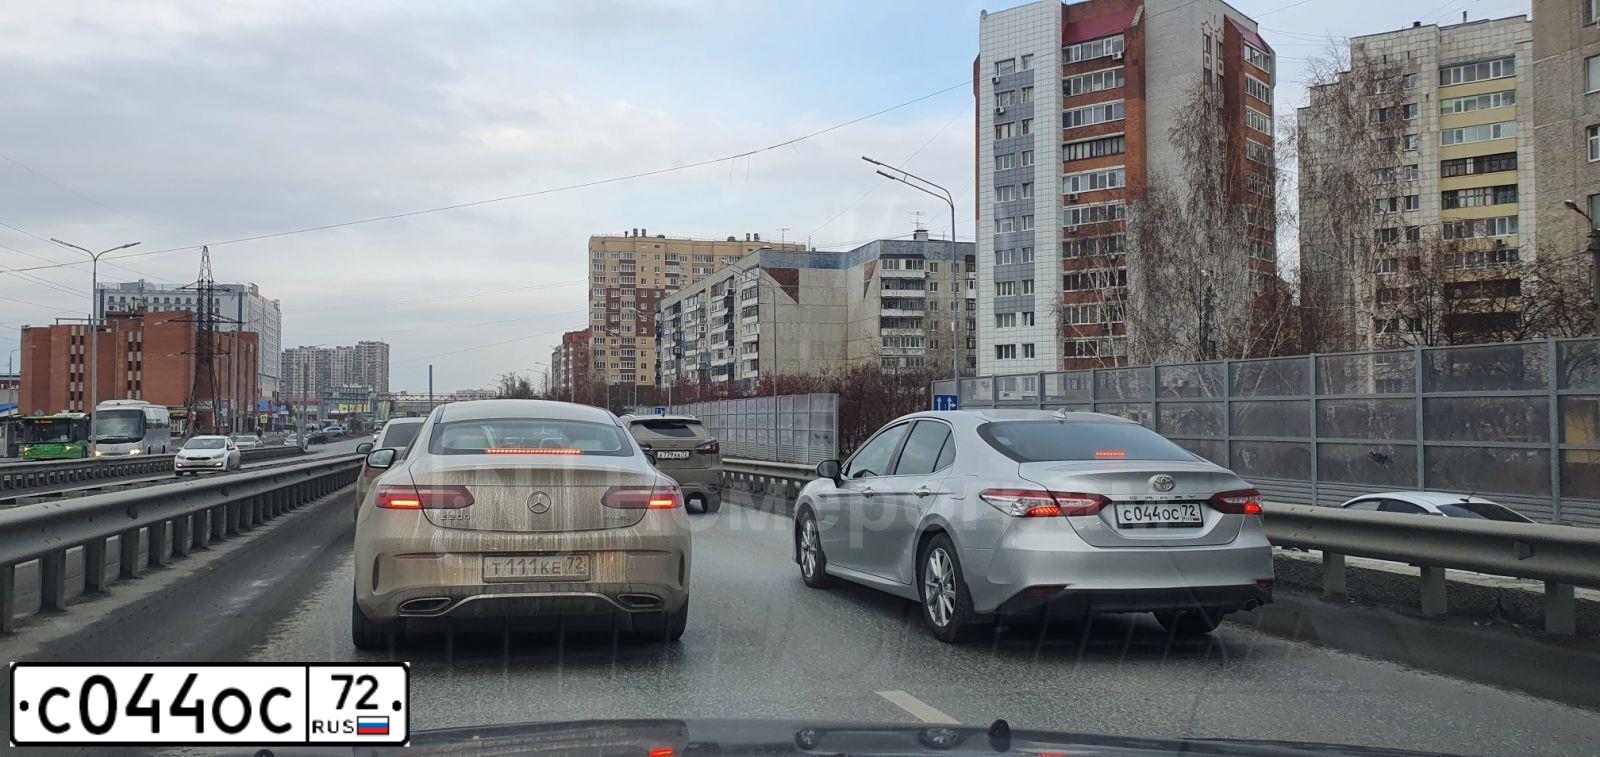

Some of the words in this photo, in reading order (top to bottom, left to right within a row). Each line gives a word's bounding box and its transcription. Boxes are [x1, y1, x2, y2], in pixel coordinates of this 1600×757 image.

[1182, 505, 1196, 516] 72
[492, 557, 561, 576] Т111КЕ
[567, 556, 583, 569] 72
